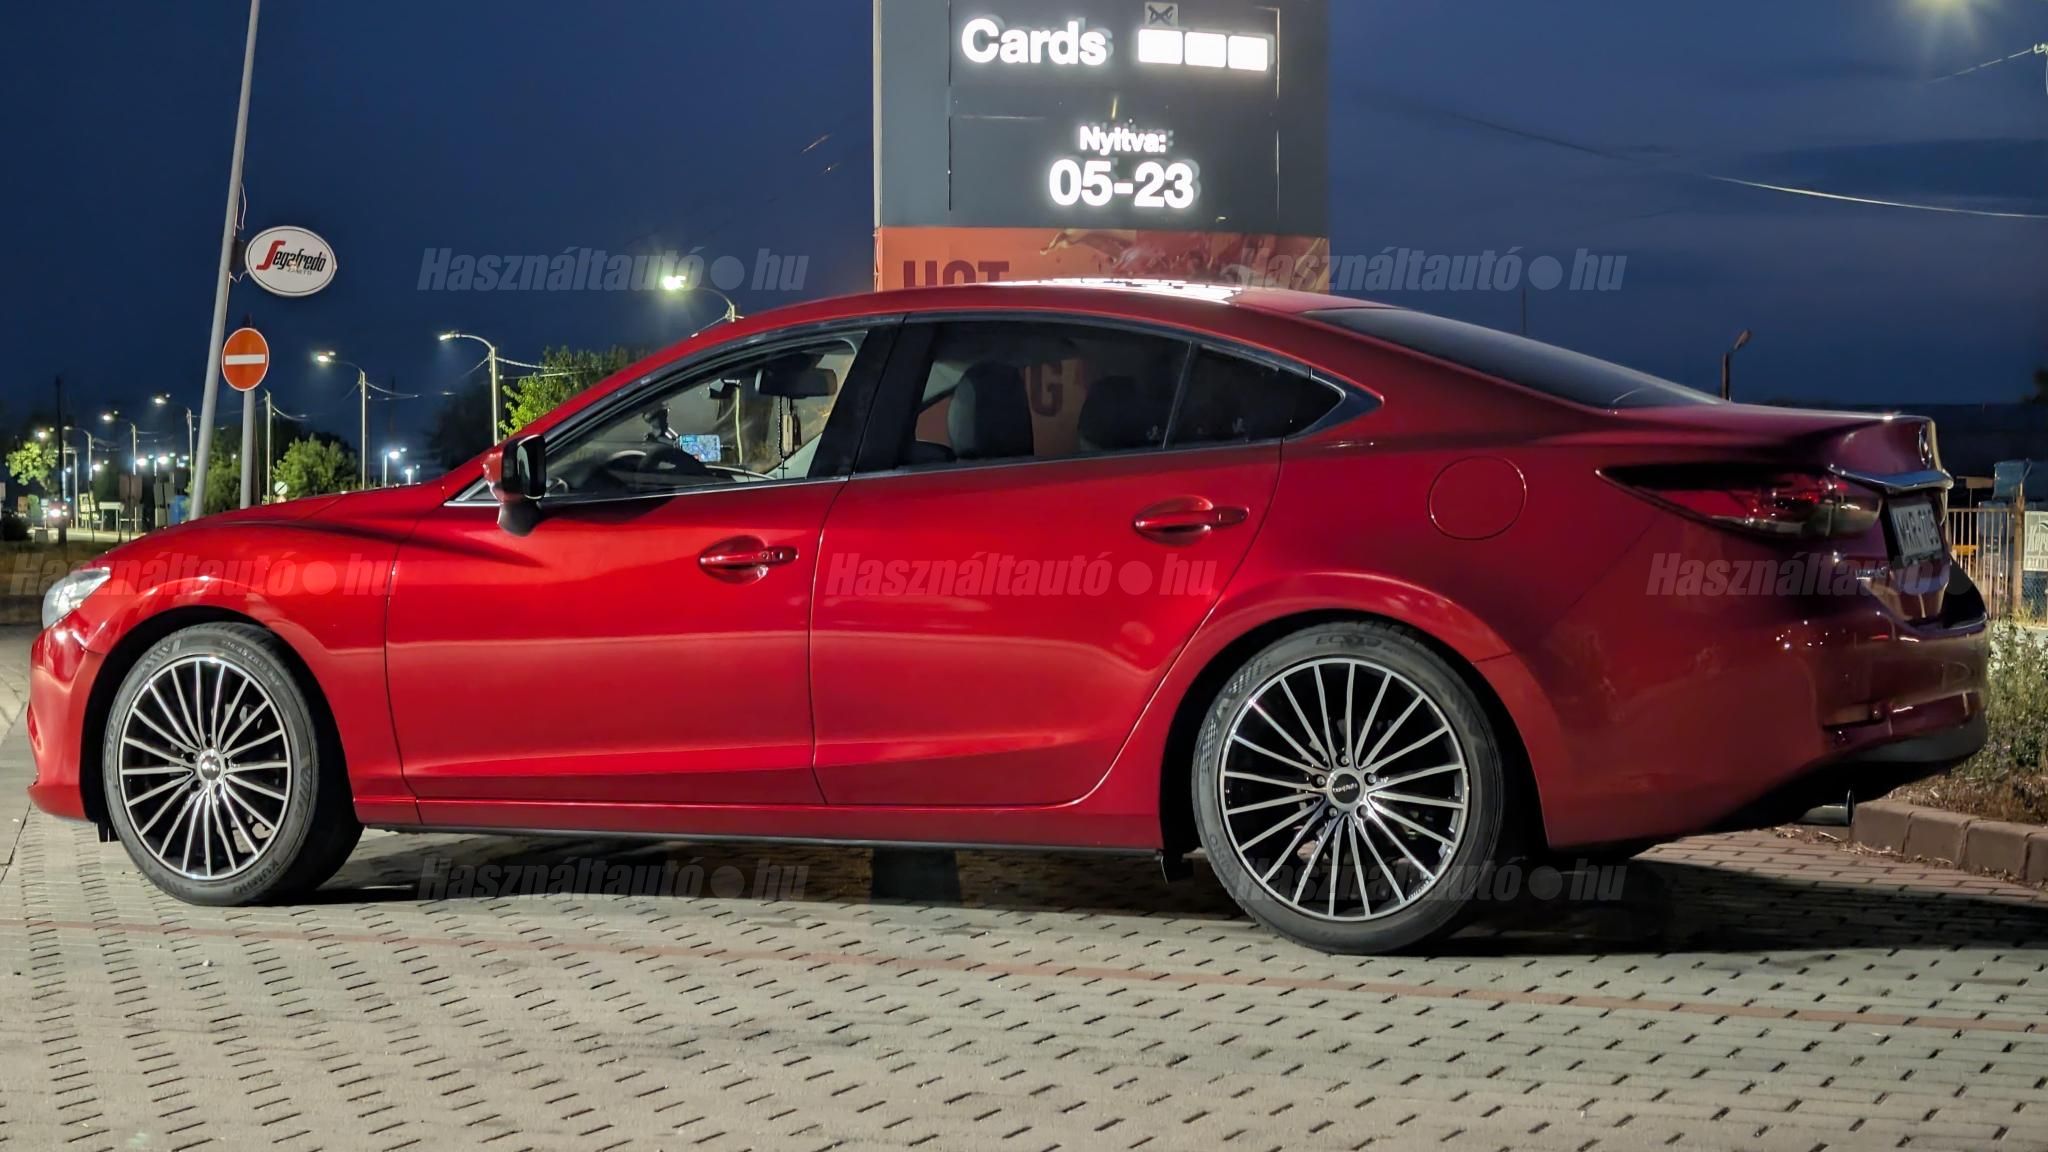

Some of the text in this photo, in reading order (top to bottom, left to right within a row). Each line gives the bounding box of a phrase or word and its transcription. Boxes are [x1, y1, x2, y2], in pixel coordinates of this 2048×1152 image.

[961, 18, 1108, 66] Cards
[1079, 125, 1168, 156] Nyitva:
[1049, 158, 1194, 208] 05-23
[256, 240, 327, 273] Segafredo
